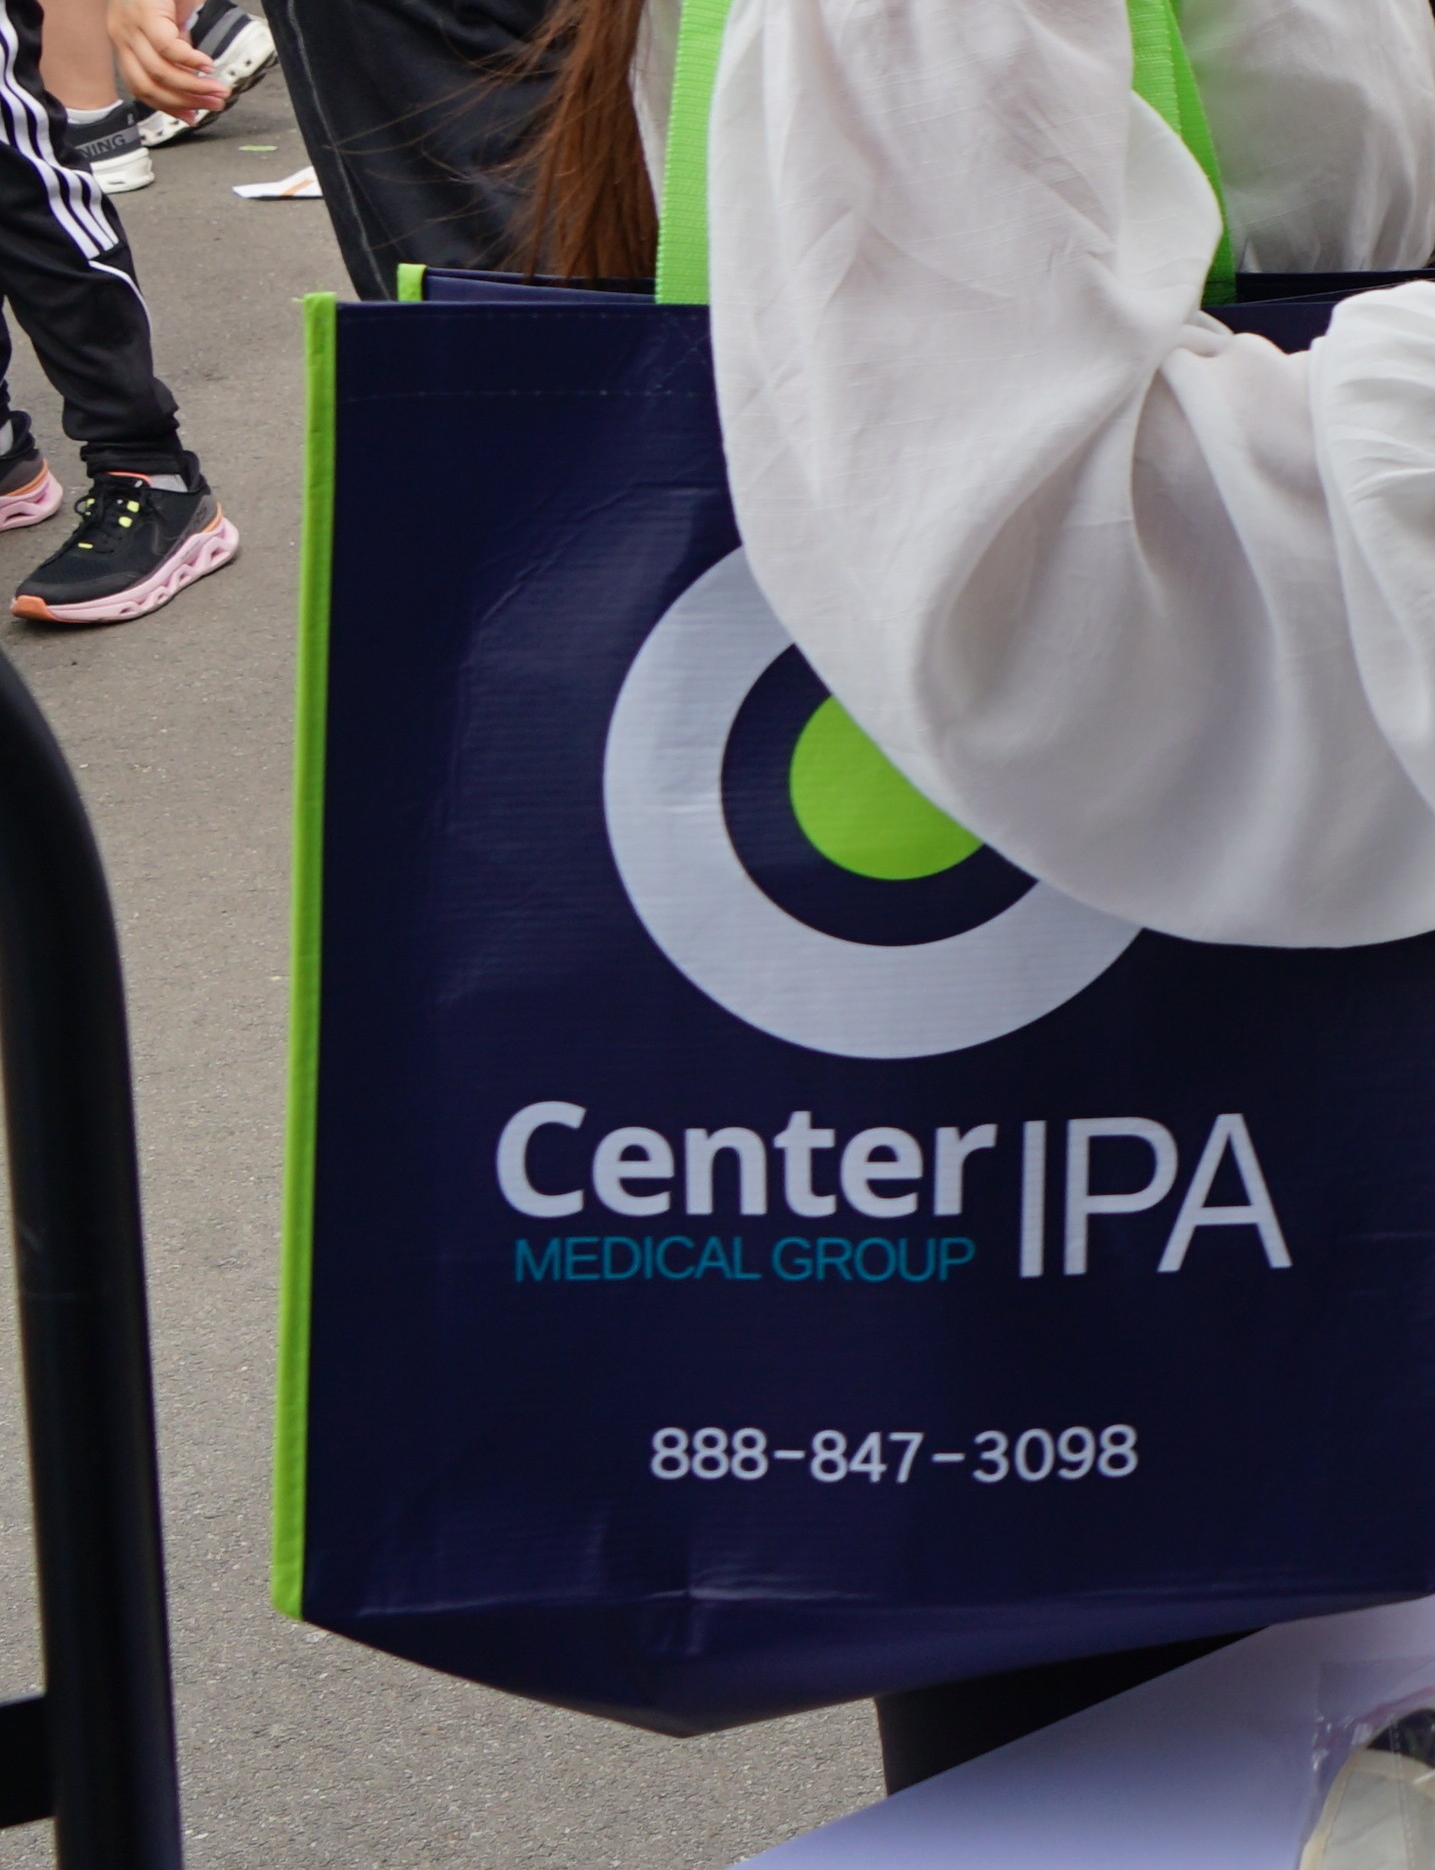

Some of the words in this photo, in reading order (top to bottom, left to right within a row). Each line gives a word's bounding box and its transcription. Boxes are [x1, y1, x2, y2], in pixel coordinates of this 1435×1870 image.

[495, 1100, 996, 1218] Center
[1020, 1113, 1292, 1279] IPA
[514, 1236, 760, 1283] MEDICAL
[772, 1236, 976, 1283] GROUP
[649, 1425, 1139, 1484] 888-847-3098
